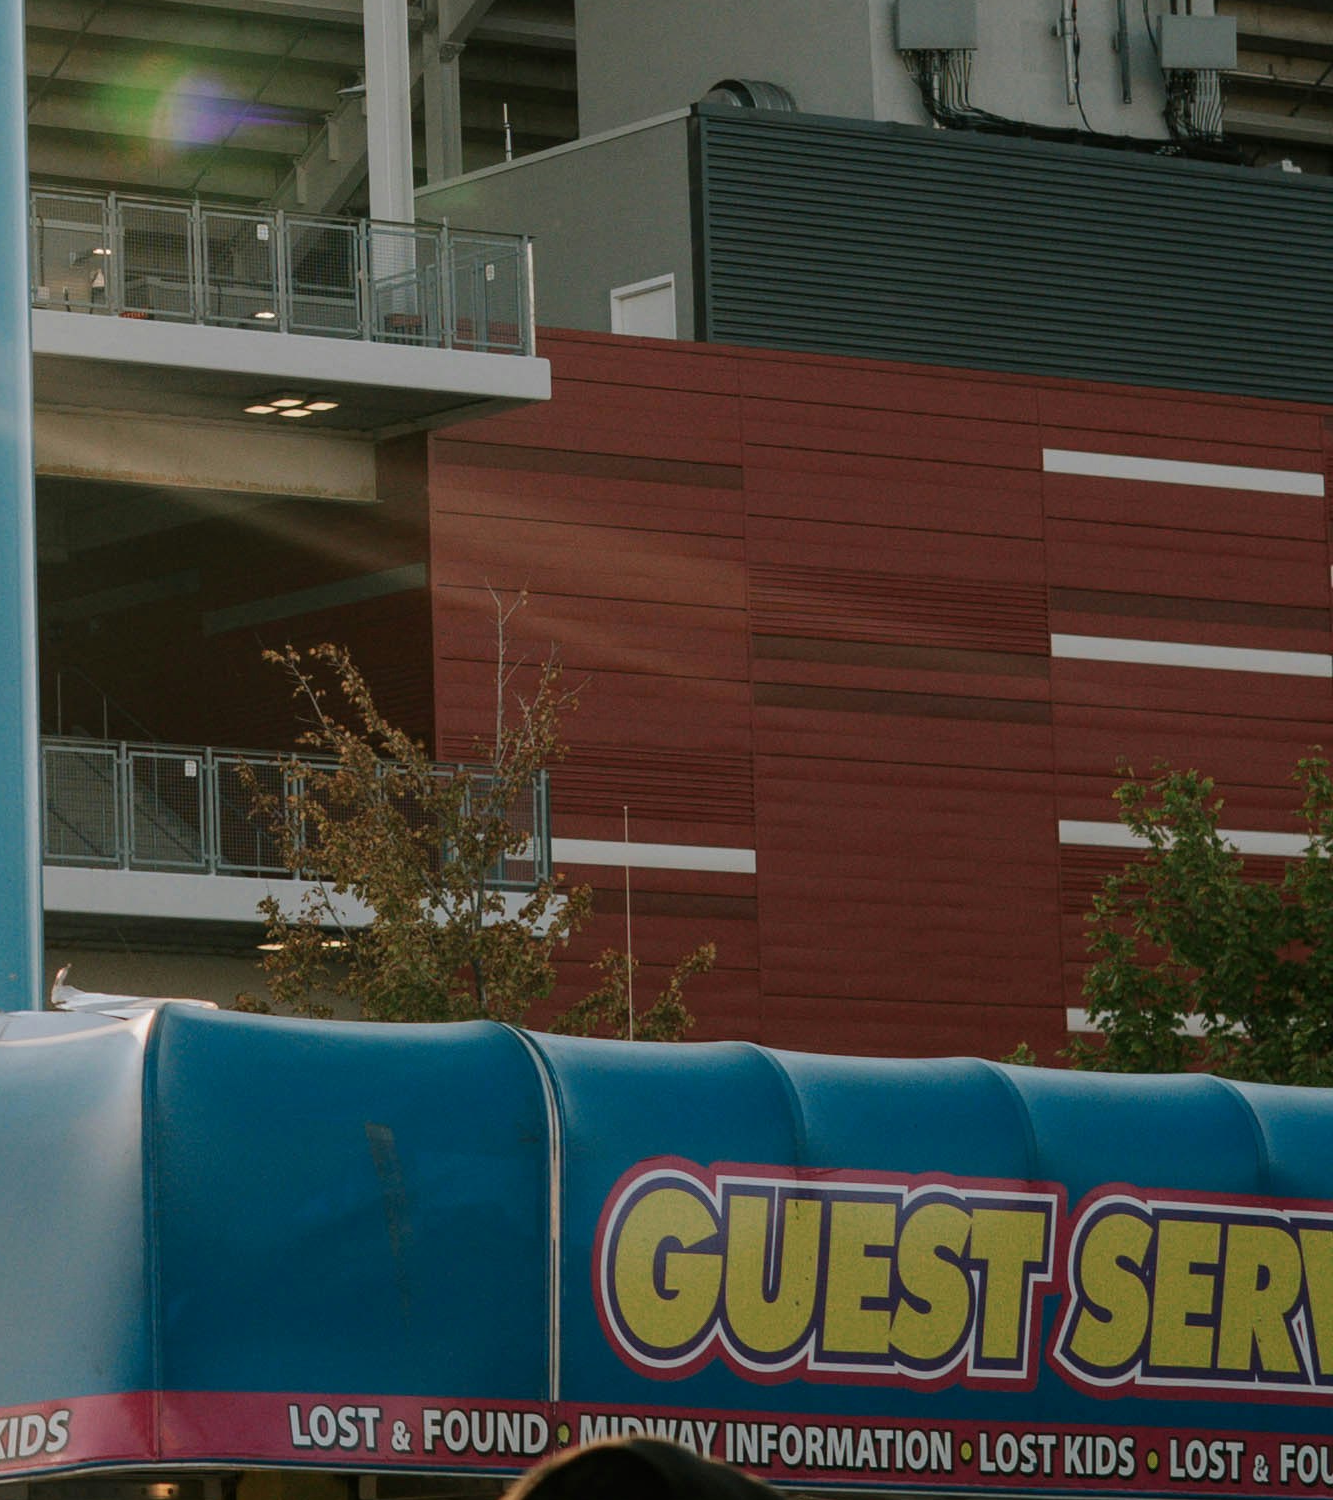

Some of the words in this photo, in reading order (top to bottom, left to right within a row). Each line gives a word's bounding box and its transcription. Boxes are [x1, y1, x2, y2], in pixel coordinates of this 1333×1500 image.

[613, 1186, 1046, 1361] GUEST
[289, 1404, 381, 1454] LOST
[391, 1418, 412, 1452] &
[422, 1408, 549, 1456] FOUND
[724, 1422, 953, 1474] INFORMATION
[979, 1432, 1053, 1478] LOST
[1064, 1435, 1136, 1478] KIDS
[1169, 1438, 1244, 1481] LOST
[1252, 1454, 1269, 1483] &
